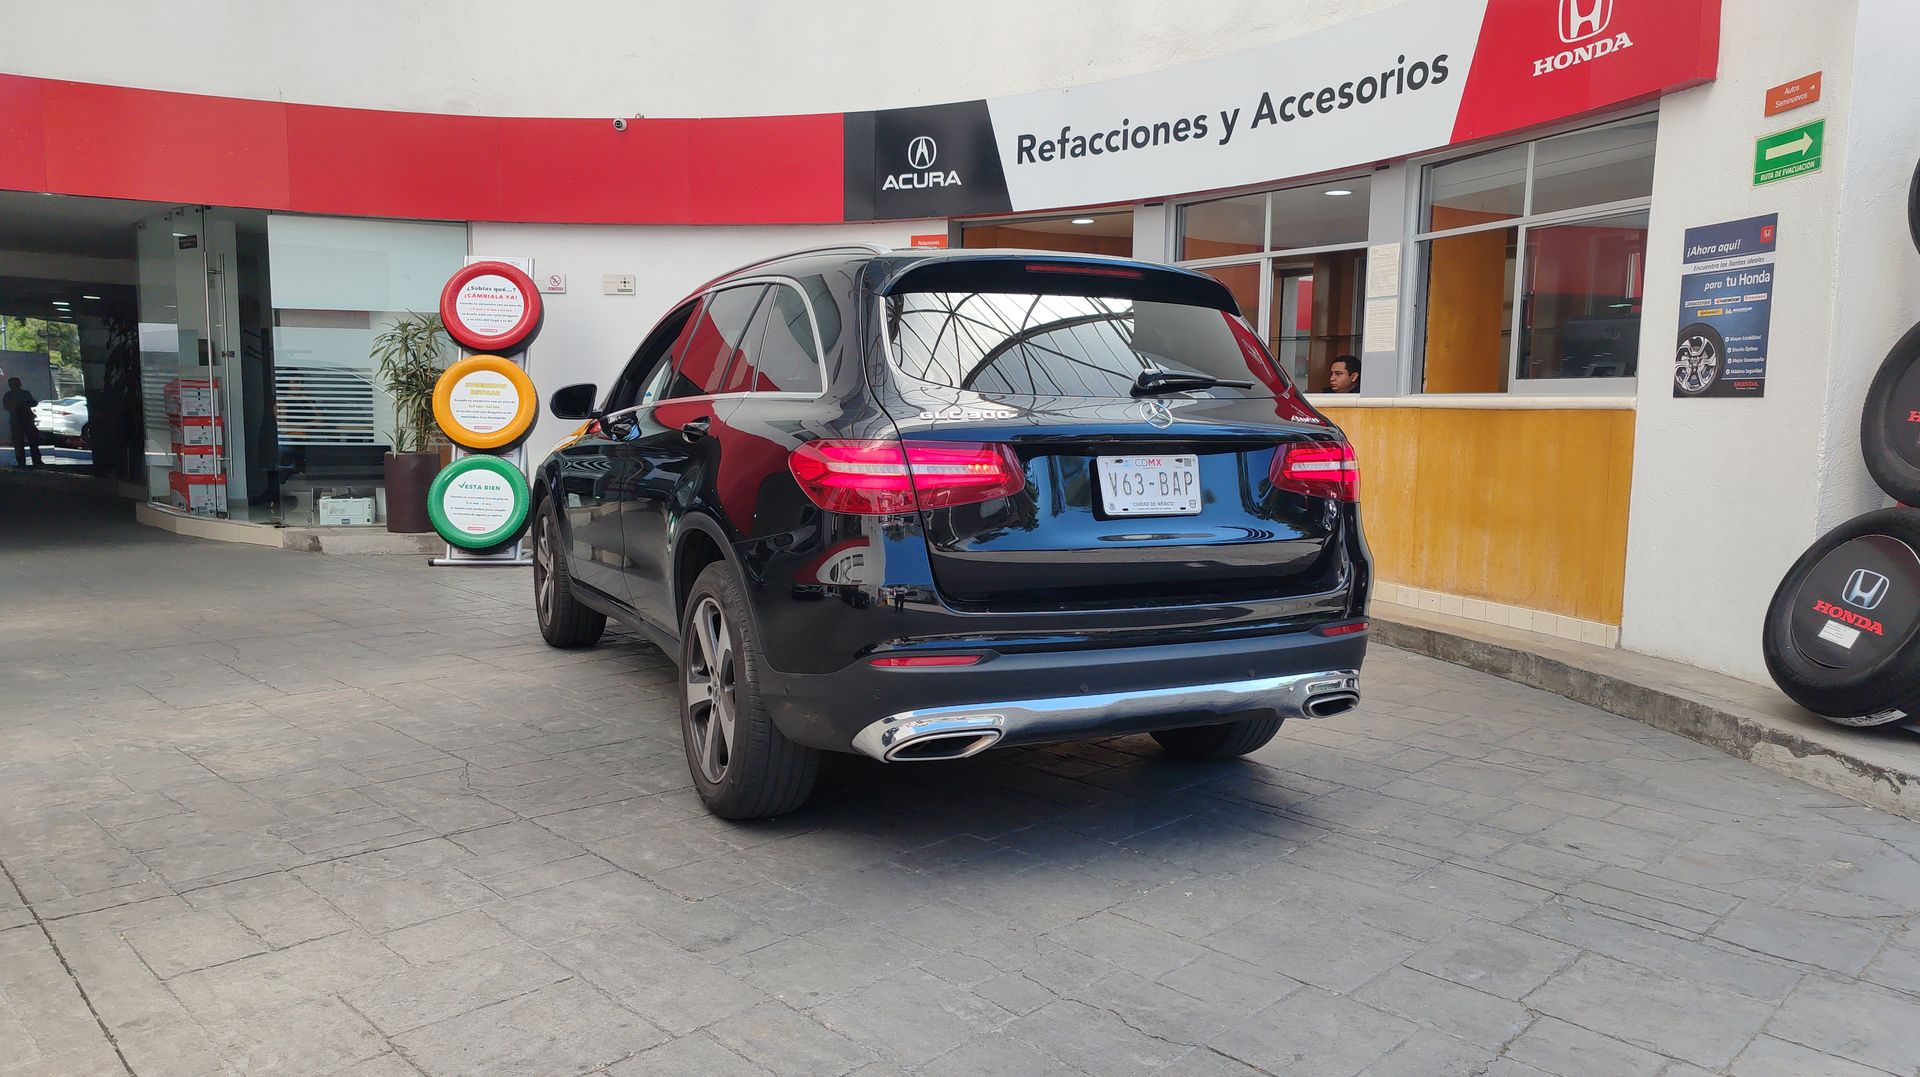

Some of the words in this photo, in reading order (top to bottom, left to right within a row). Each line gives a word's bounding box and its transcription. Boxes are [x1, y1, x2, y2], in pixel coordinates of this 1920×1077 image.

[1533, 32, 1633, 76] HONDA
[1784, 84, 1800, 95] Autos
[1017, 113, 1208, 165] Refacciones
[1218, 107, 1240, 145] y
[1250, 53, 1449, 129] Accesorios
[1775, 92, 1808, 109] Seminuevos
[882, 170, 962, 190] ACURA
[1760, 171, 1774, 181] RUTA
[1775, 168, 1782, 178] DE
[1687, 245, 1716, 258] ¡Ahora
[1718, 239, 1741, 253] aquí!
[1693, 262, 1719, 271] Encuentra
[1728, 258, 1746, 267] llantas
[1747, 256, 1765, 265] ideales
[1704, 281, 1722, 292] para
[1726, 276, 1737, 287] tu
[1738, 270, 1770, 286] Honda
[920, 411, 961, 420] GLC
[968, 410, 1010, 420] 300
[1135, 459, 1162, 467] CDMX
[1108, 471, 1193, 497] V63-BAP
[1813, 600, 1884, 636] HONDA
